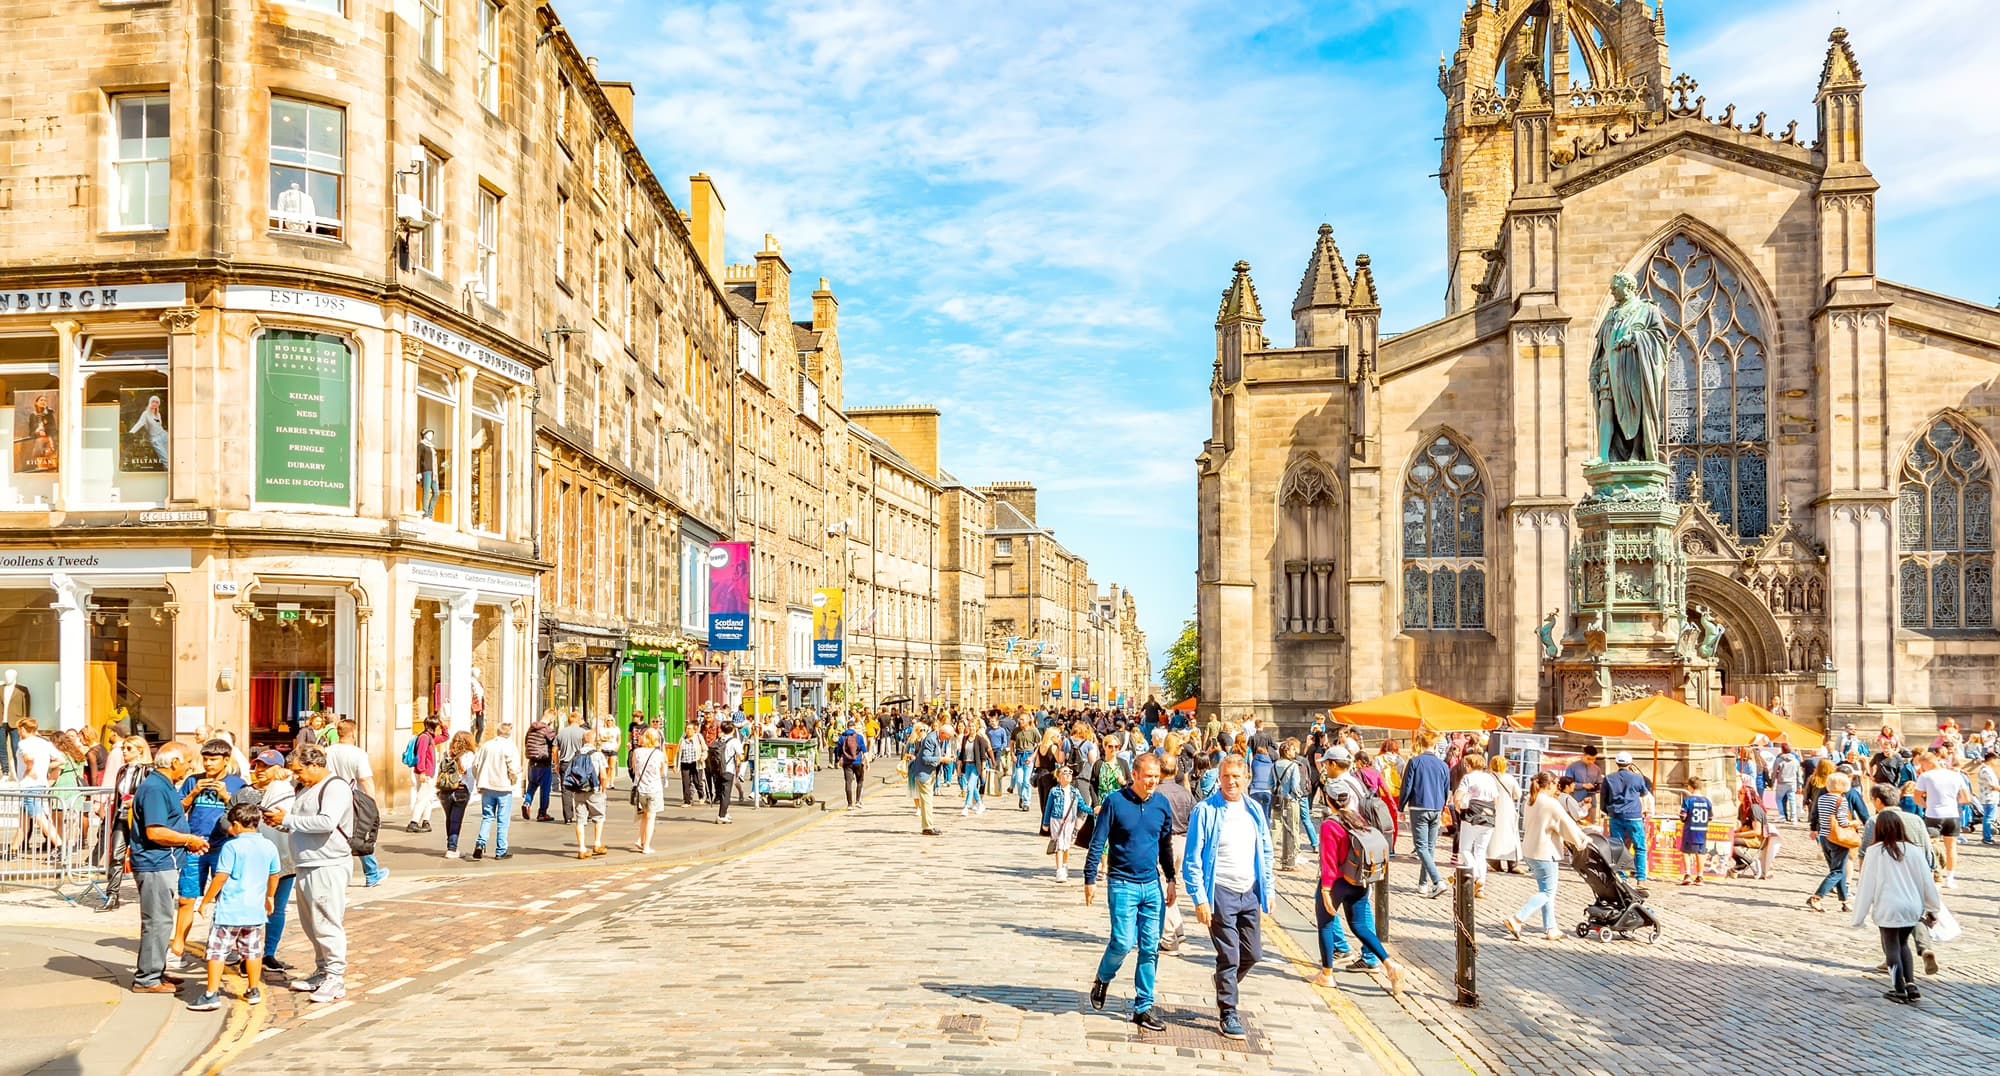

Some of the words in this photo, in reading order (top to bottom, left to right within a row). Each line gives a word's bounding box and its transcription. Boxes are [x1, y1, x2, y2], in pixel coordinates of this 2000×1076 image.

[0, 289, 118, 311] NBURGH
[270, 289, 304, 305] EST
[315, 295, 345, 311] 1985
[274, 345, 312, 354] HOUSE
[412, 320, 449, 346] HOUSE
[457, 341, 471, 356] OF
[478, 350, 531, 381] EDINBURGH
[274, 353, 337, 366] EDINBURGH
[289, 392, 325, 402] KILTANE
[296, 410, 318, 418] NESS
[275, 425, 307, 435] HARRIS
[308, 428, 337, 437] TWEED
[288, 444, 325, 453] PRINGLE
[287, 461, 326, 471] DUBARRY
[265, 477, 290, 486] MADE
[303, 479, 345, 489] SCOTLAND
[178, 511, 206, 520] STREET
[0, 555, 44, 567] oollens
[46, 555, 54, 567] &
[58, 555, 99, 567] Tweeds
[714, 618, 744, 627] Scotland
[1691, 808, 1709, 823] 30
